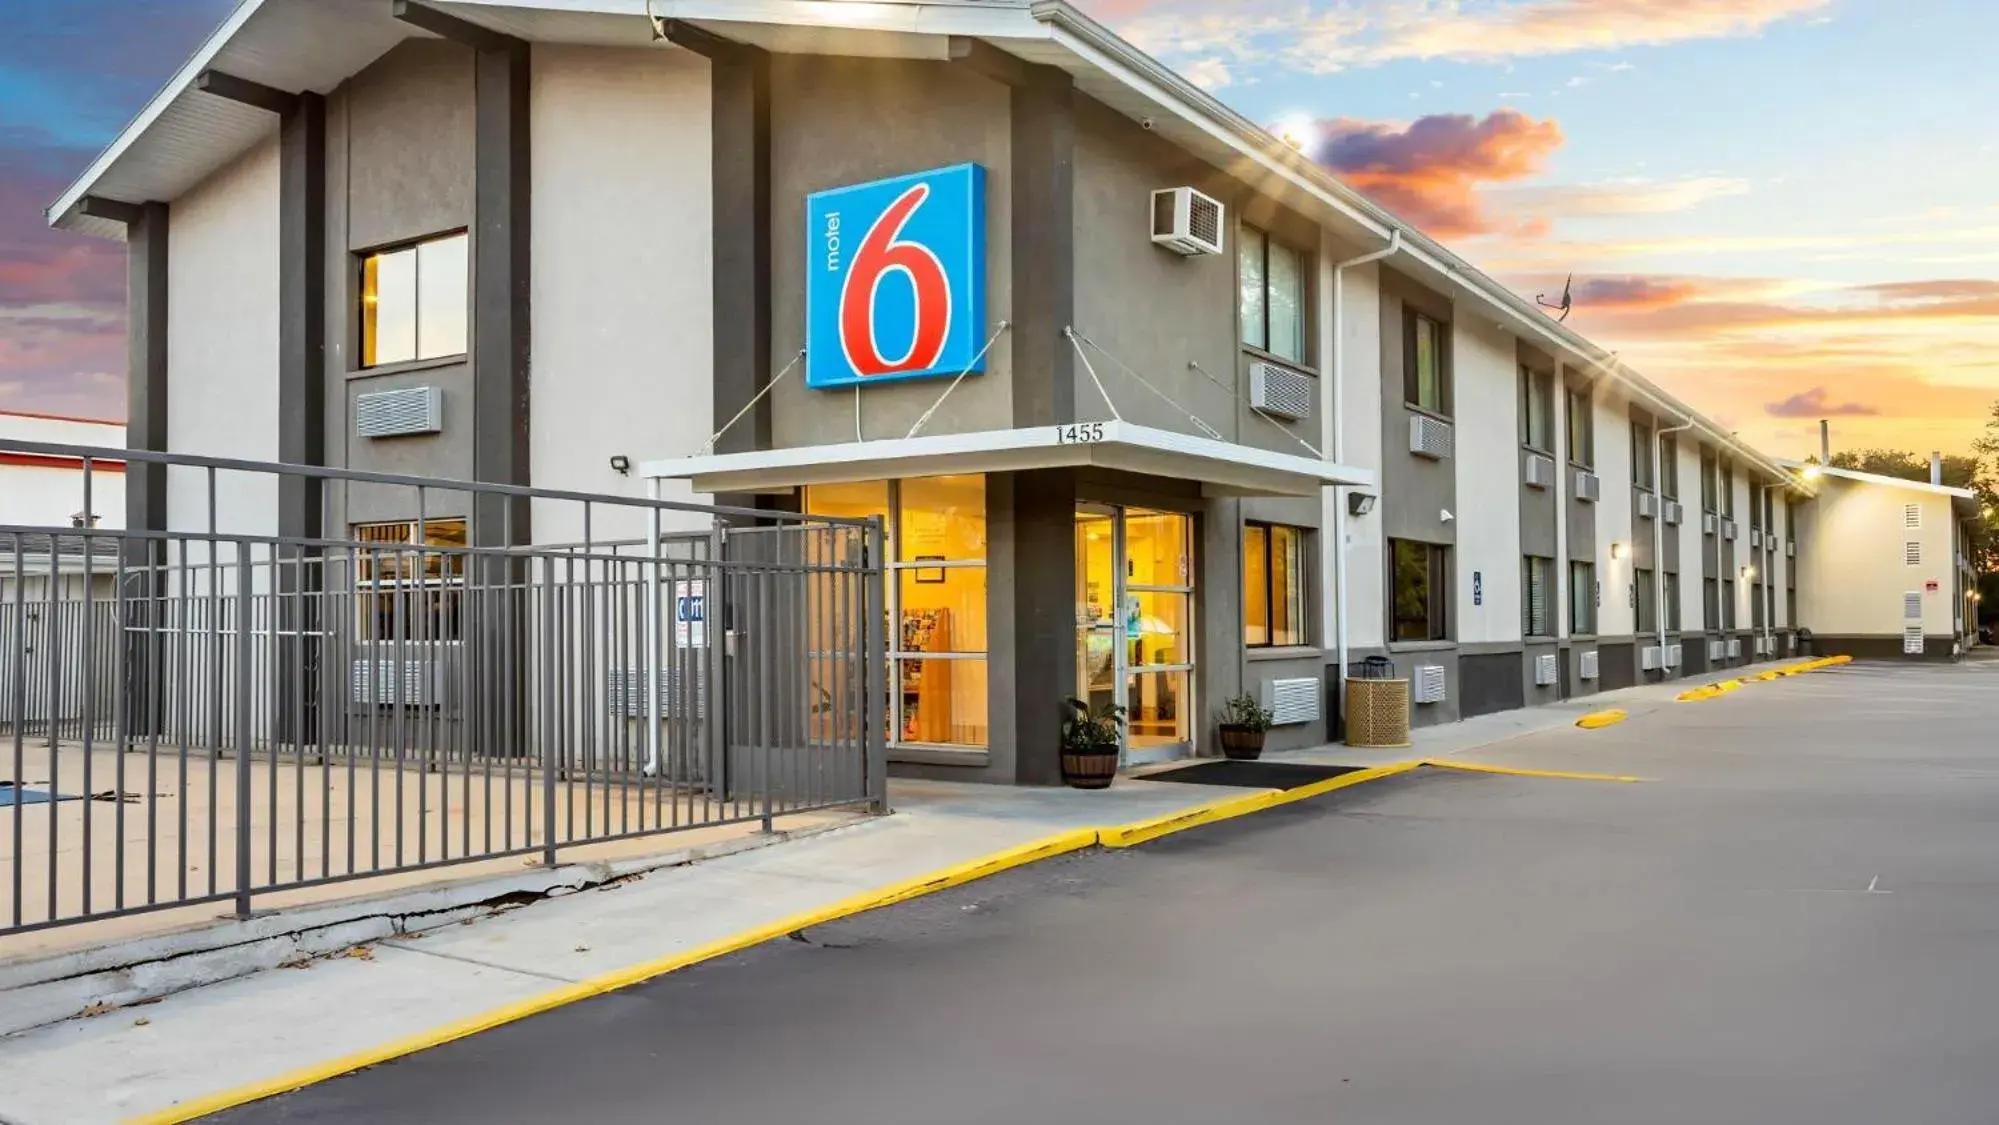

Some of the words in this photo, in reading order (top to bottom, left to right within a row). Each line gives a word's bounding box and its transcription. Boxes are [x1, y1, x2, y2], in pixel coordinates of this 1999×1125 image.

[825, 211, 841, 271] motel
[838, 182, 952, 377] 6
[1056, 423, 1103, 444] 1455
